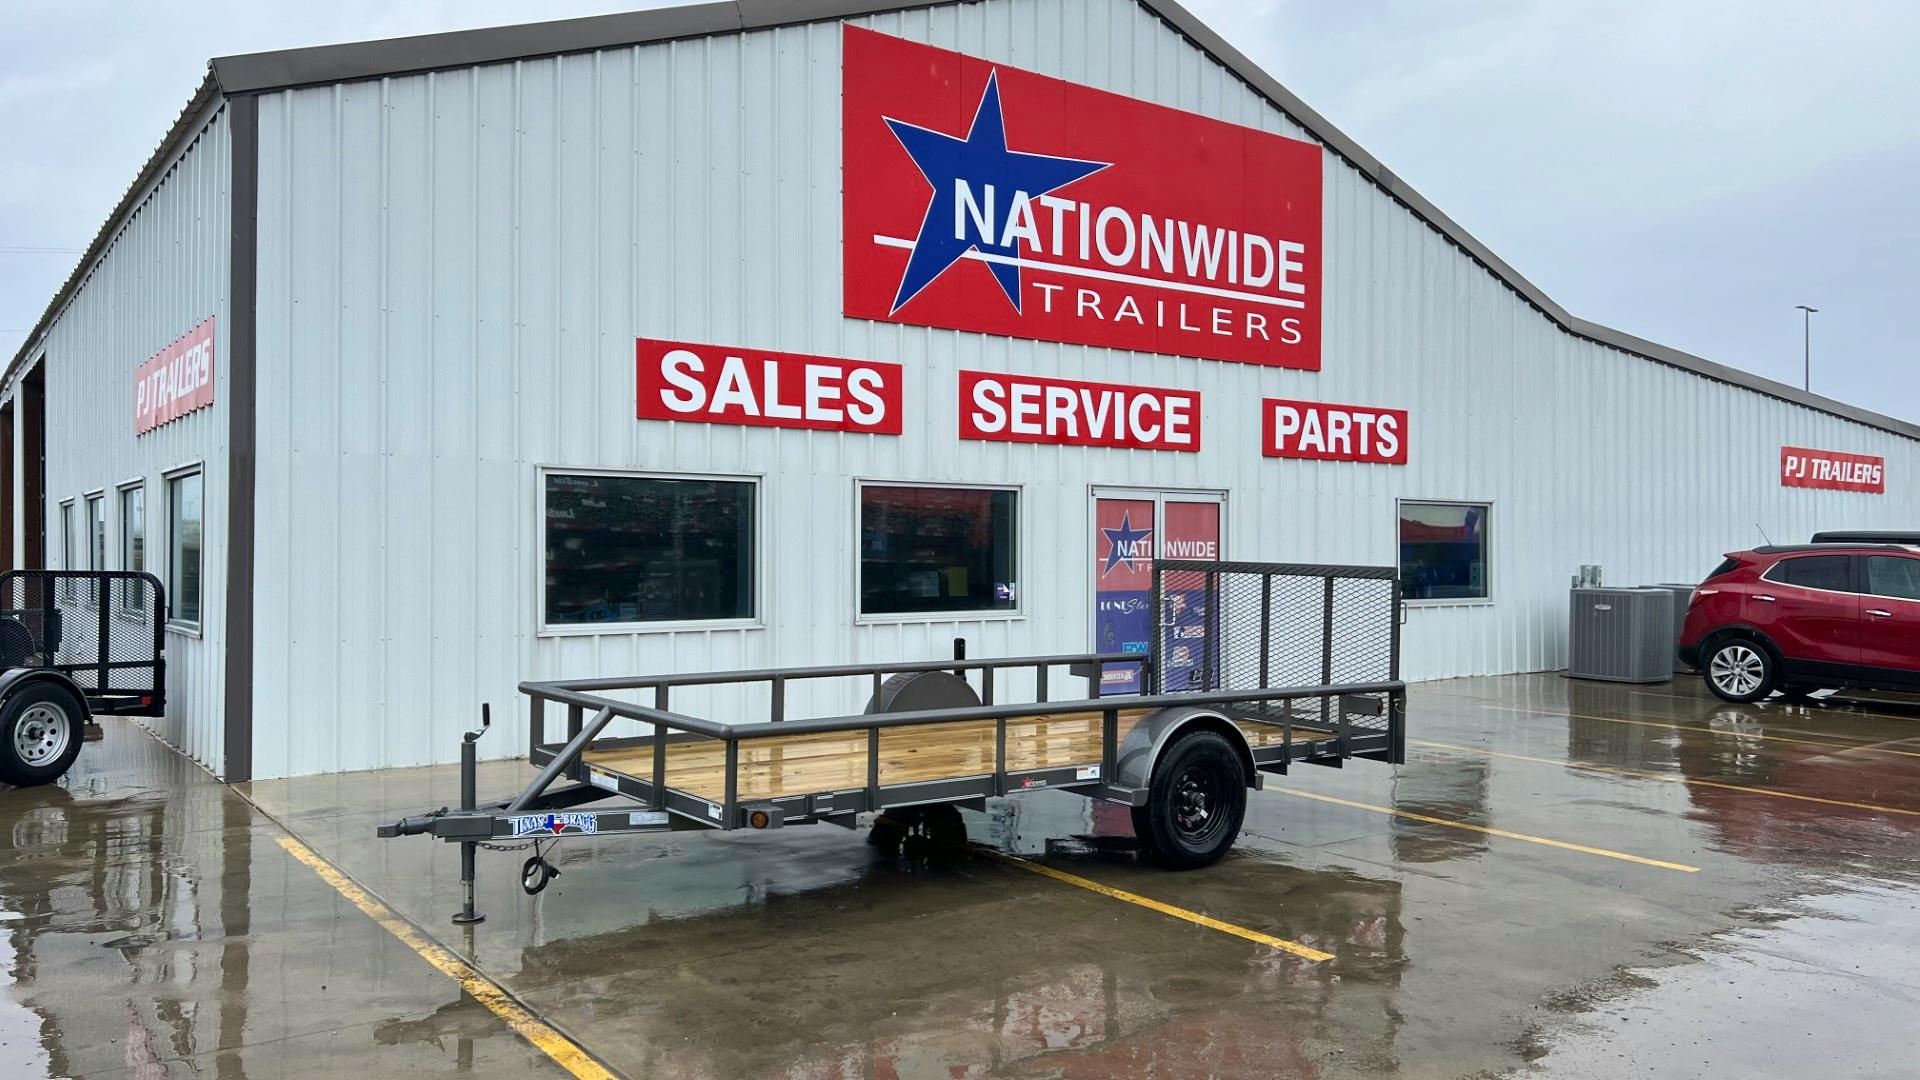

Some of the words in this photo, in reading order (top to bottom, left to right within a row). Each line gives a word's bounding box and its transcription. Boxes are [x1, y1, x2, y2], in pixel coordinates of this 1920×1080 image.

[954, 178, 1305, 294] NATIONWIDE
[1032, 283, 1302, 345] TRAILERS
[136, 376, 151, 418] PJ
[152, 337, 211, 411] TRAILERS
[659, 350, 886, 425] SALES
[972, 379, 1191, 444] SERVICE
[1274, 405, 1399, 458] PARTS
[1785, 455, 1806, 477] PJ
[1811, 459, 1881, 485] TRAILERS
[508, 814, 545, 838] TEXAS
[562, 812, 598, 834] BRAGG
